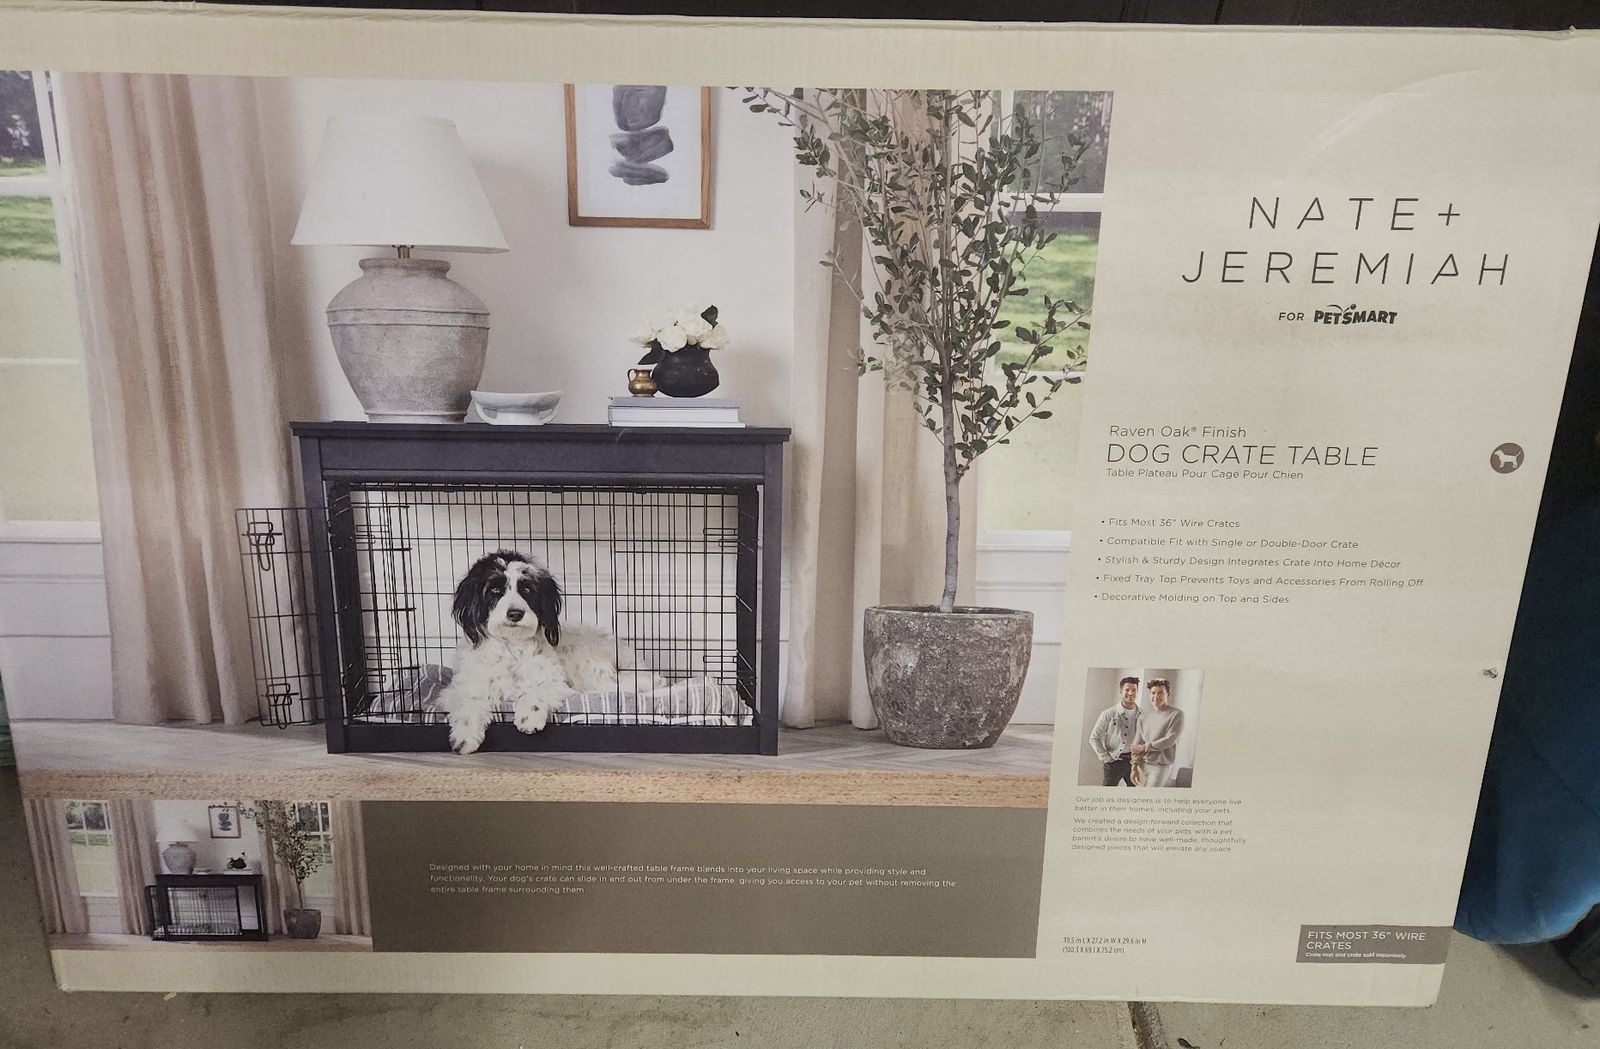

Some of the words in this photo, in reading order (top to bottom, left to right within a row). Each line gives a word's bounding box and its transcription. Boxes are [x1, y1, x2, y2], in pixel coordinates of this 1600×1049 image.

[1181, 251, 1508, 285] JEREMIAH
[1277, 311, 1304, 323] FOR
[1313, 308, 1398, 325] PETSMART
[1109, 425, 1155, 437] Raven
[1201, 426, 1247, 438] Finish
[1106, 443, 1170, 463] DOG
[1180, 444, 1276, 465] CRATE
[1286, 446, 1378, 466] TABLE
[1105, 468, 1134, 478] Table
[1137, 468, 1178, 478] Plateau
[1181, 469, 1207, 478] Pour
[1210, 469, 1239, 481] Cage
[1242, 470, 1269, 479] Pour
[1271, 470, 1303, 480] Chien
[1108, 518, 1128, 527] Fits
[1130, 518, 1155, 527] Most
[1178, 518, 1204, 527] Wire
[1206, 519, 1240, 528] Crates
[1106, 537, 1166, 549] Compatible
[1168, 538, 1183, 547] Fit
[1185, 538, 1208, 547] with
[1210, 538, 1243, 550] Single
[1245, 540, 1257, 548] or
[1259, 539, 1328, 548] Double-Door
[1329, 539, 1359, 549] Crate
[1104, 555, 1139, 567] Stylish
[1141, 556, 1149, 565] &
[1151, 556, 1186, 568] Sturdy
[1188, 557, 1225, 568] Design
[1227, 557, 1280, 569] Integrates
[1281, 558, 1311, 567] Crate
[1313, 558, 1334, 567] Into
[1336, 558, 1368, 568] Home
[1102, 574, 1131, 583] Fixed
[1133, 574, 1155, 586] Tray
[1158, 575, 1177, 586] Top
[1179, 575, 1224, 584] Prevents
[1227, 575, 1250, 587] Toys
[1252, 576, 1272, 585] and
[1275, 576, 1336, 586] Accessories
[1338, 577, 1366, 586] From
[1369, 577, 1404, 589] Rolling
[1407, 578, 1423, 587] Off
[1100, 593, 1156, 602] Decorative
[1158, 593, 1199, 605] Molding
[1217, 594, 1237, 605] Top
[1239, 594, 1259, 603] and
[1261, 594, 1290, 604] Sides
[429, 864, 469, 873] Designed
[472, 864, 490, 872] with
[493, 866, 511, 874] your
[575, 865, 590, 873] this
[593, 865, 643, 873] well-crafted
[697, 866, 725, 874] blends
[746, 868, 765, 876] your
[768, 867, 790, 876] living
[820, 867, 842, 875] while
[844, 868, 884, 877] providing
[887, 868, 907, 877] style
[430, 875, 484, 884] functionality.
[509, 876, 532, 885] dog's
[577, 876, 596, 884] slide
[644, 877, 664, 885] from
[666, 877, 691, 885] under
[739, 878, 765, 887] giving
[826, 880, 846, 888] your
[848, 879, 862, 888] pet
[865, 879, 897, 887] without
[900, 880, 939, 889] removing
[508, 886, 559, 895] surrounding
[1307, 931, 1333, 939] FITS
[1335, 931, 1369, 940] MOST
[1393, 932, 1426, 941] WIRE
[1305, 942, 1352, 950] CRATES
